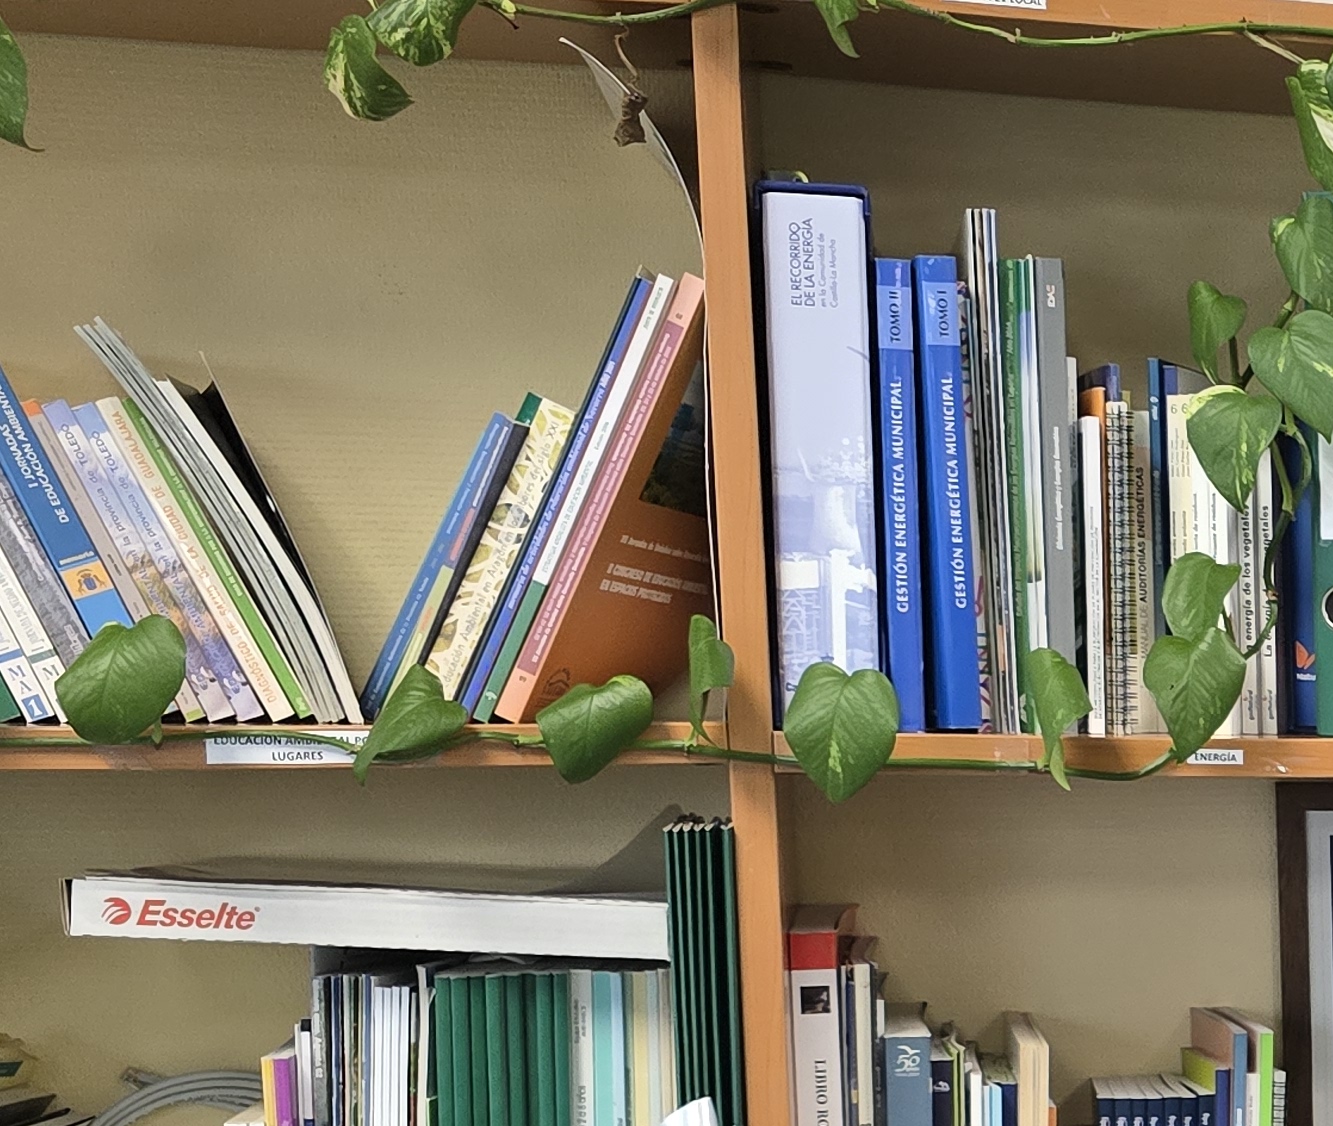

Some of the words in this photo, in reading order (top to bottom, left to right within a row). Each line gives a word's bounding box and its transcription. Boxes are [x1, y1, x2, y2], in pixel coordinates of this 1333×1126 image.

[788, 221, 804, 292] RECORRIDO
[799, 217, 815, 271] ENERGÍA
[788, 293, 803, 306] EL
[801, 273, 816, 289] LA
[802, 293, 817, 308] DE
[887, 303, 902, 344] TOMO
[889, 462, 908, 548] ENERGÉTICA
[945, 458, 965, 544] ENERGÉTICA
[892, 551, 910, 614] GESTIÓN
[950, 547, 968, 610] GESTIÓN
[271, 751, 323, 761] LUGARES
[1195, 750, 1238, 762] ENERGÍA
[136, 899, 256, 930] Esselte
[813, 1059, 829, 1105] LIBRO
